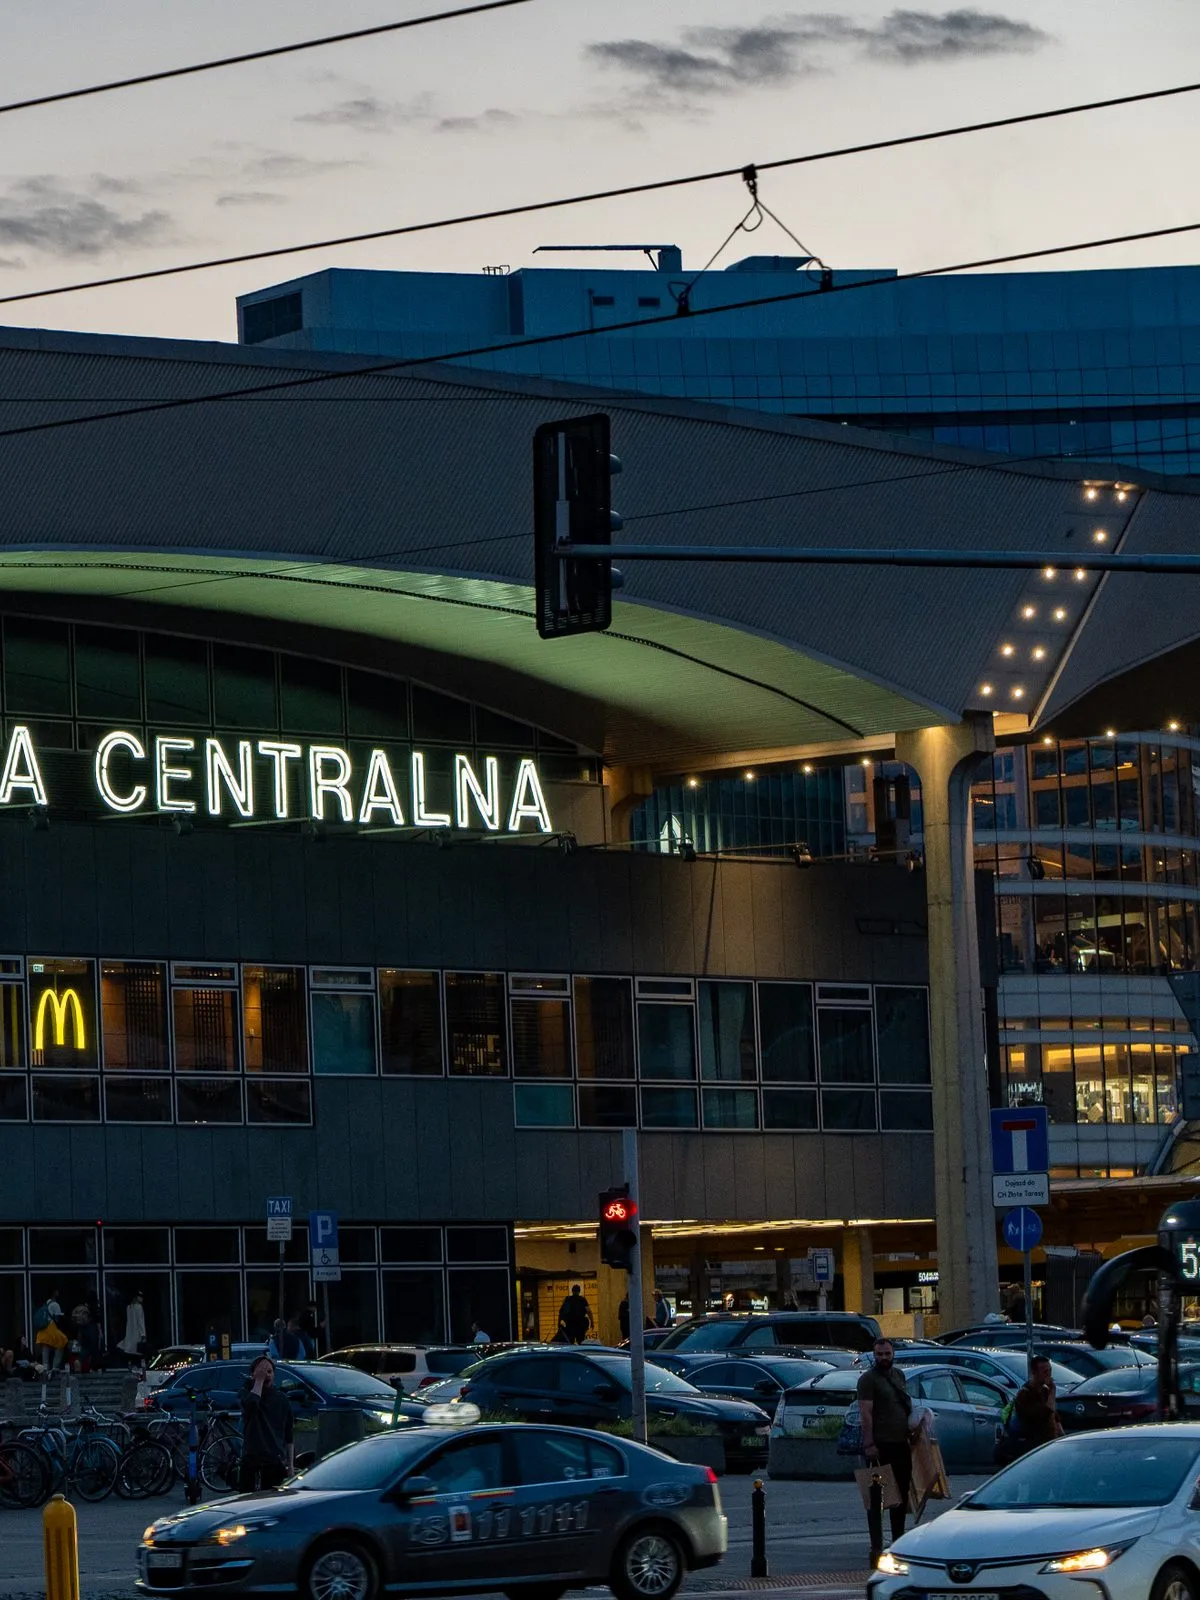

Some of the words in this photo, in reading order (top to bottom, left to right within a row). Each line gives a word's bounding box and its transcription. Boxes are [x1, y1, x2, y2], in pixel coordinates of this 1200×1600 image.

[94, 730, 553, 833] CENTRALNA
[1027, 1179, 1036, 1187] do
[1024, 1190, 1045, 1198] Tarasy
[268, 1200, 291, 1214] TAXI
[317, 1215, 333, 1244] P
[1181, 1243, 1200, 1280] 5
